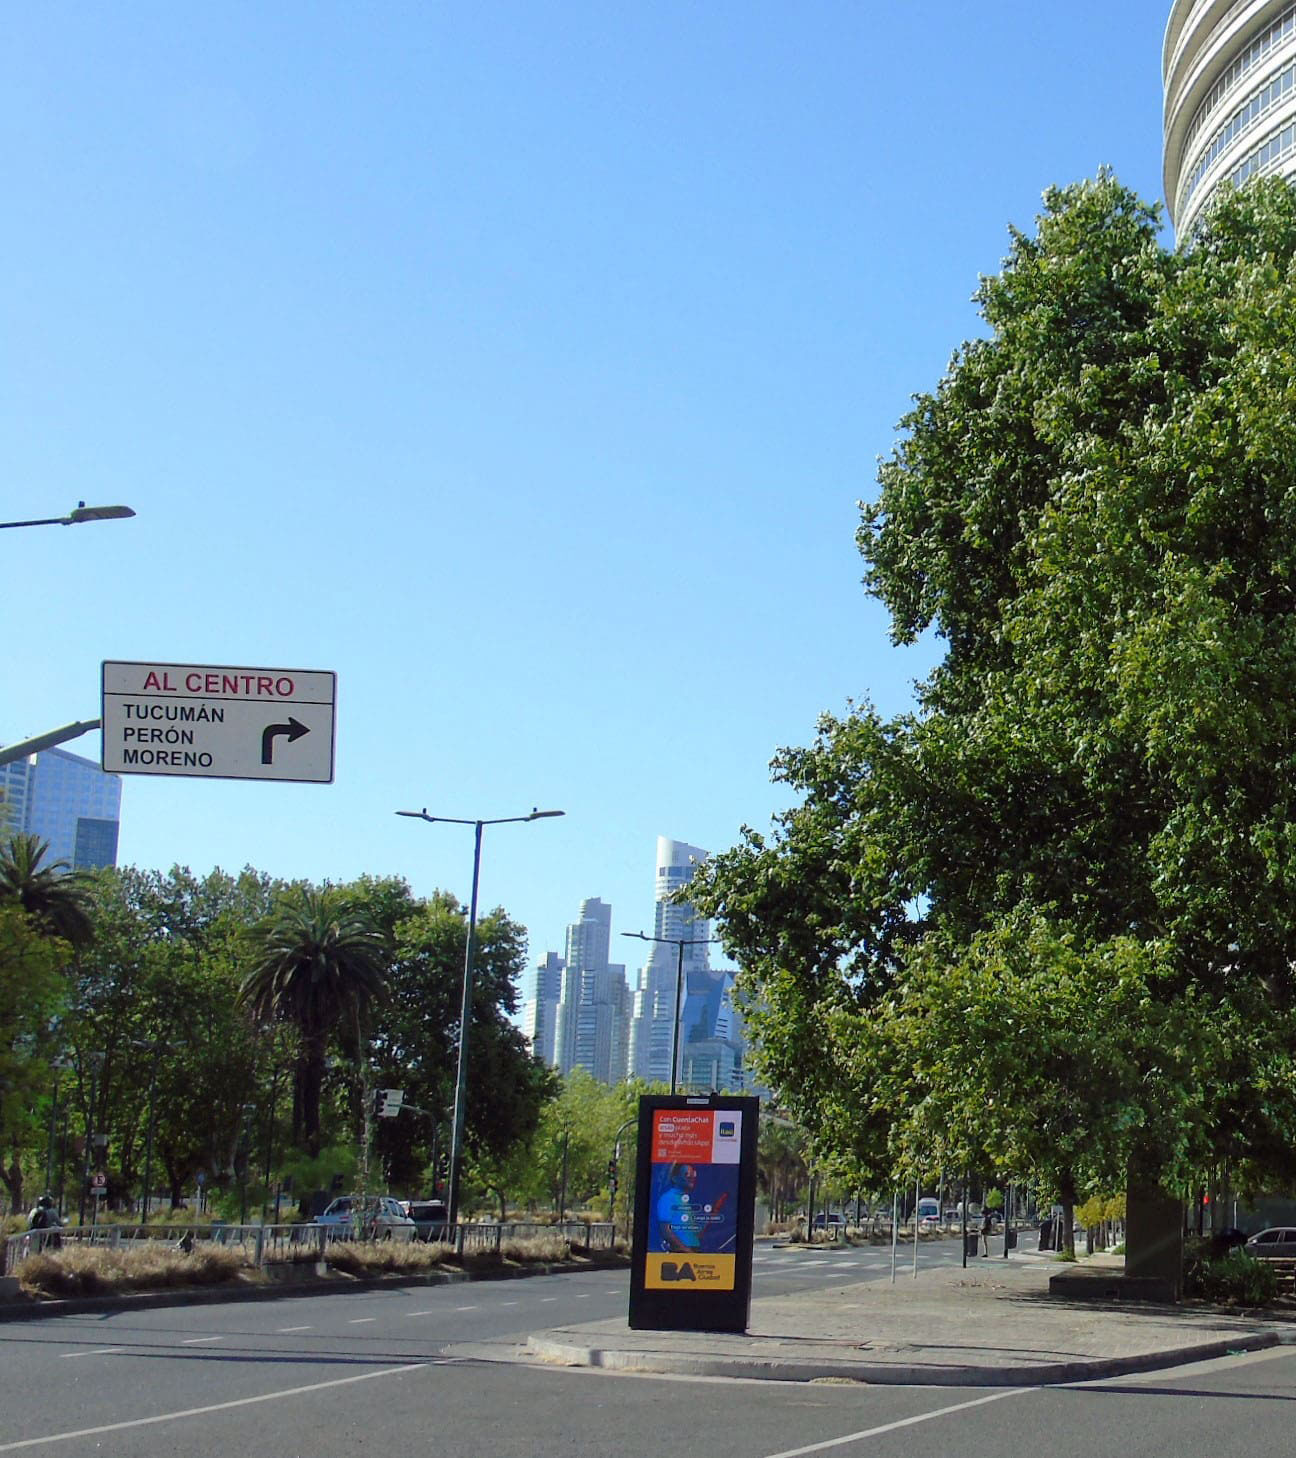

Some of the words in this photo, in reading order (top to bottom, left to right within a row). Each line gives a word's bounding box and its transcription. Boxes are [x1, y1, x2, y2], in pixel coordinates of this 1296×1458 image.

[143, 671, 177, 691] AL
[185, 672, 295, 697] CENTRO
[123, 703, 224, 723] TUCUMÁN
[123, 726, 194, 745] PERÓN
[123, 749, 213, 768] MORENO
[661, 1262, 697, 1282] BA
